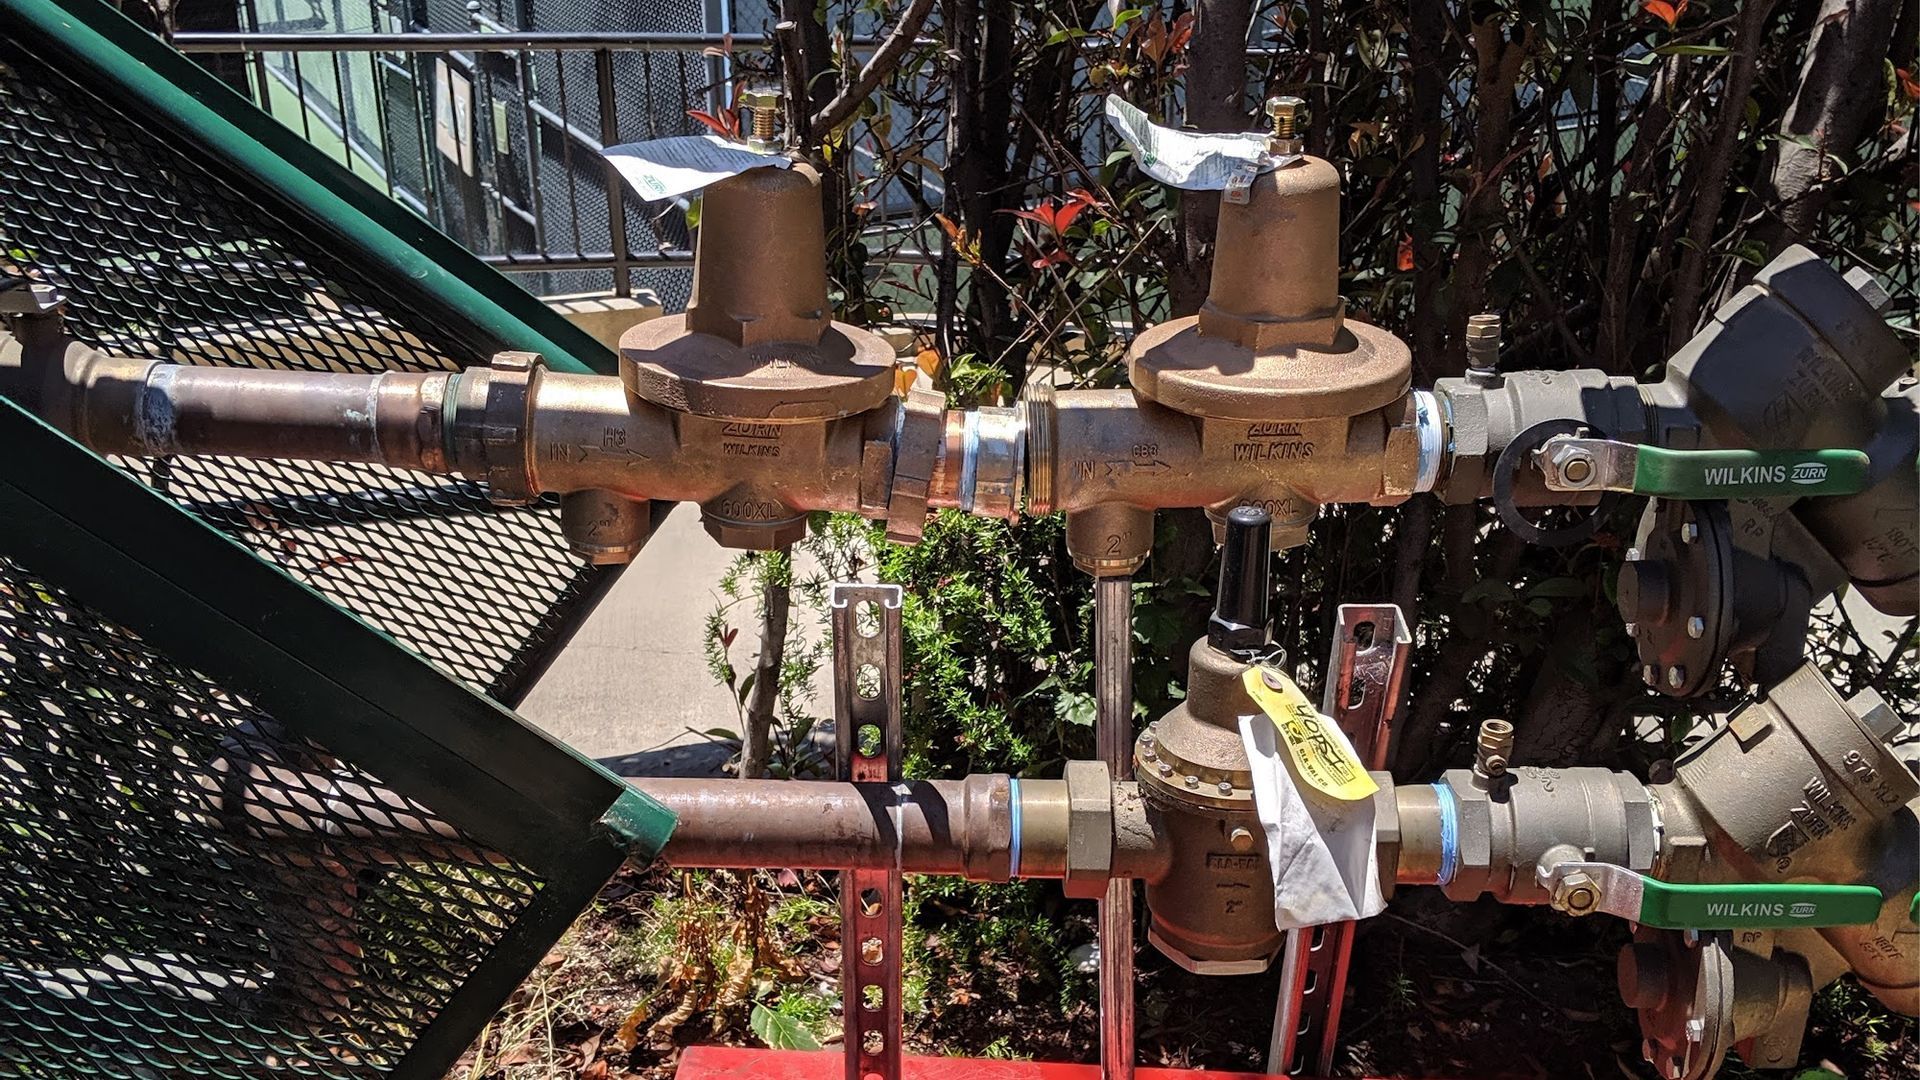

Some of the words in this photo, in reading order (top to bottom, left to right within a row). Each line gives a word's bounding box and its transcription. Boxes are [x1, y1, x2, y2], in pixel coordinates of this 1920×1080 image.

[550, 442, 571, 461] IN
[723, 442, 781, 457] WILKINS
[1234, 442, 1315, 462] WILKINS
[1705, 466, 1786, 485] WILKINS
[1791, 466, 1828, 481] ZURN
[722, 500, 779, 520] 600XL
[1707, 903, 1784, 917] WILKINS
[1789, 905, 1816, 915] ZURN
